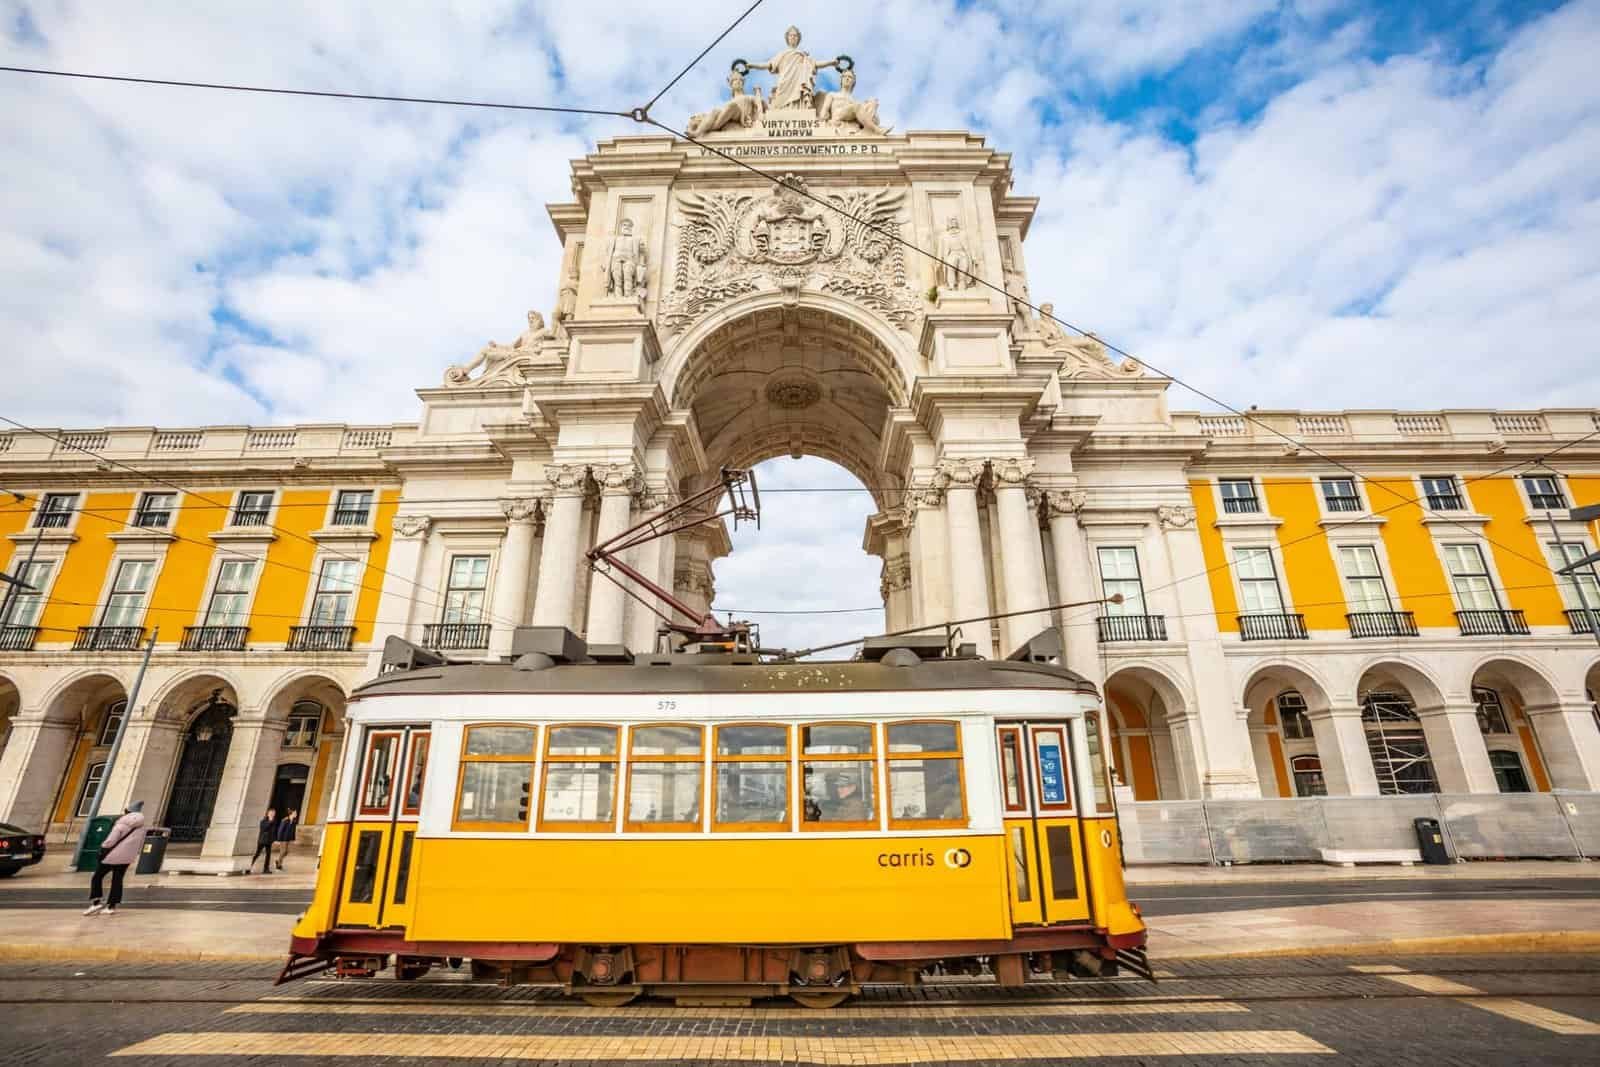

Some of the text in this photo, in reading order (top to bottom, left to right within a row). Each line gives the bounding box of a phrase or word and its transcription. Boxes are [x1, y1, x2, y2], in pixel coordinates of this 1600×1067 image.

[761, 120, 820, 128] VIRTVTIBVS
[768, 129, 813, 137] MAIORVM
[736, 145, 779, 156] OMNIBVS
[657, 700, 677, 711] 575
[877, 847, 935, 868] carris
